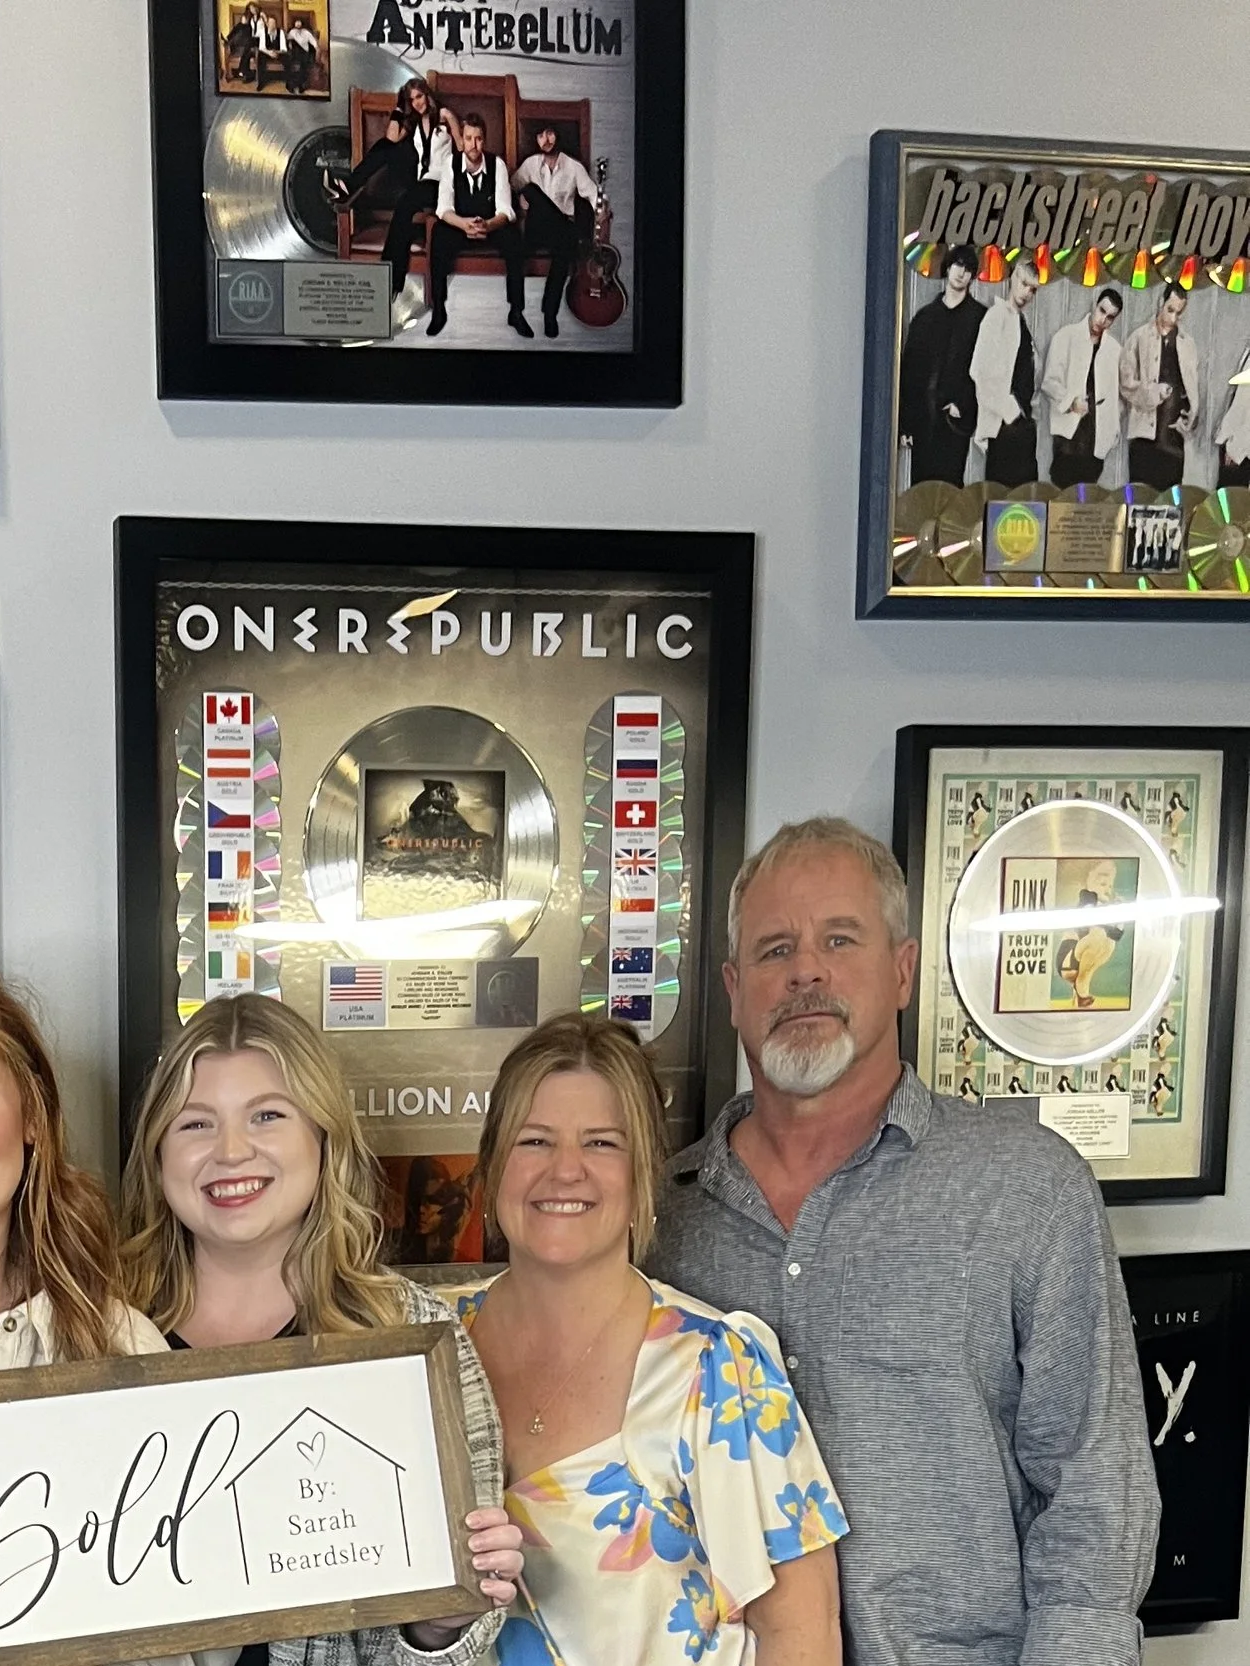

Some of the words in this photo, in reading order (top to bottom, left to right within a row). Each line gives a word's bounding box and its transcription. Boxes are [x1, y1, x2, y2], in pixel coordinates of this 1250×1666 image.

[366, 0, 622, 56] ANTEBELLUM
[918, 168, 1167, 250] backstreet
[1172, 182, 1250, 264] boy
[239, 282, 265, 300] RIAA
[176, 604, 693, 659] ONEREPUBLIC
[1008, 934, 1049, 947] TRUTH
[1009, 948, 1045, 958] ABOUT
[1006, 960, 1047, 975] LOVE
[349, 1005, 363, 1013] USA
[348, 1086, 452, 1116] LLION
[1154, 1310, 1200, 1326] LINE
[298, 1477, 338, 1501] By:
[287, 1508, 358, 1537] Sarah
[268, 1541, 387, 1576] Beardsley
